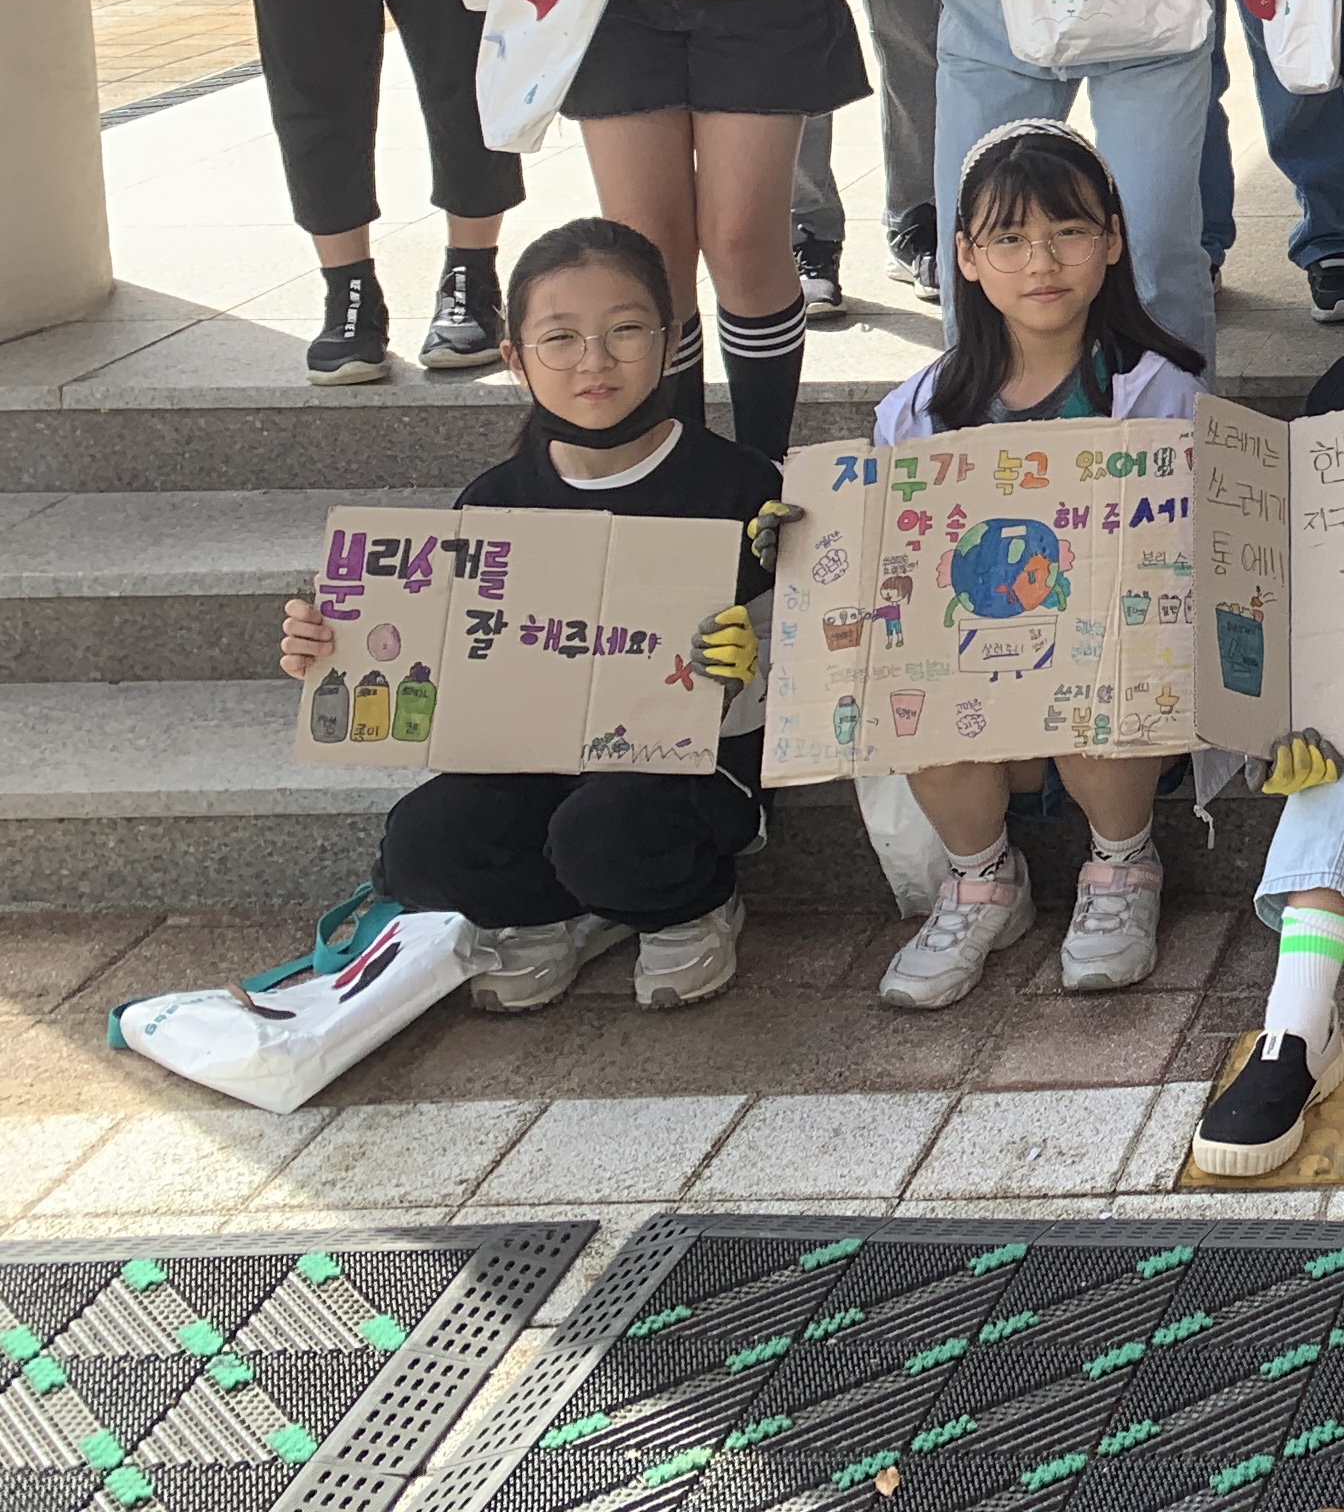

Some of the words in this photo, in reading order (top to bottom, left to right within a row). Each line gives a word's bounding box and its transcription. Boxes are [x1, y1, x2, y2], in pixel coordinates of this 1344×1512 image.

[1204, 415, 1281, 469] 쓰레기는
[832, 450, 976, 502] 지구가
[993, 449, 1051, 496] 녹고
[1206, 466, 1287, 526] 쓰레기
[319, 529, 512, 621] 분리수거를
[465, 609, 509, 660] 잘
